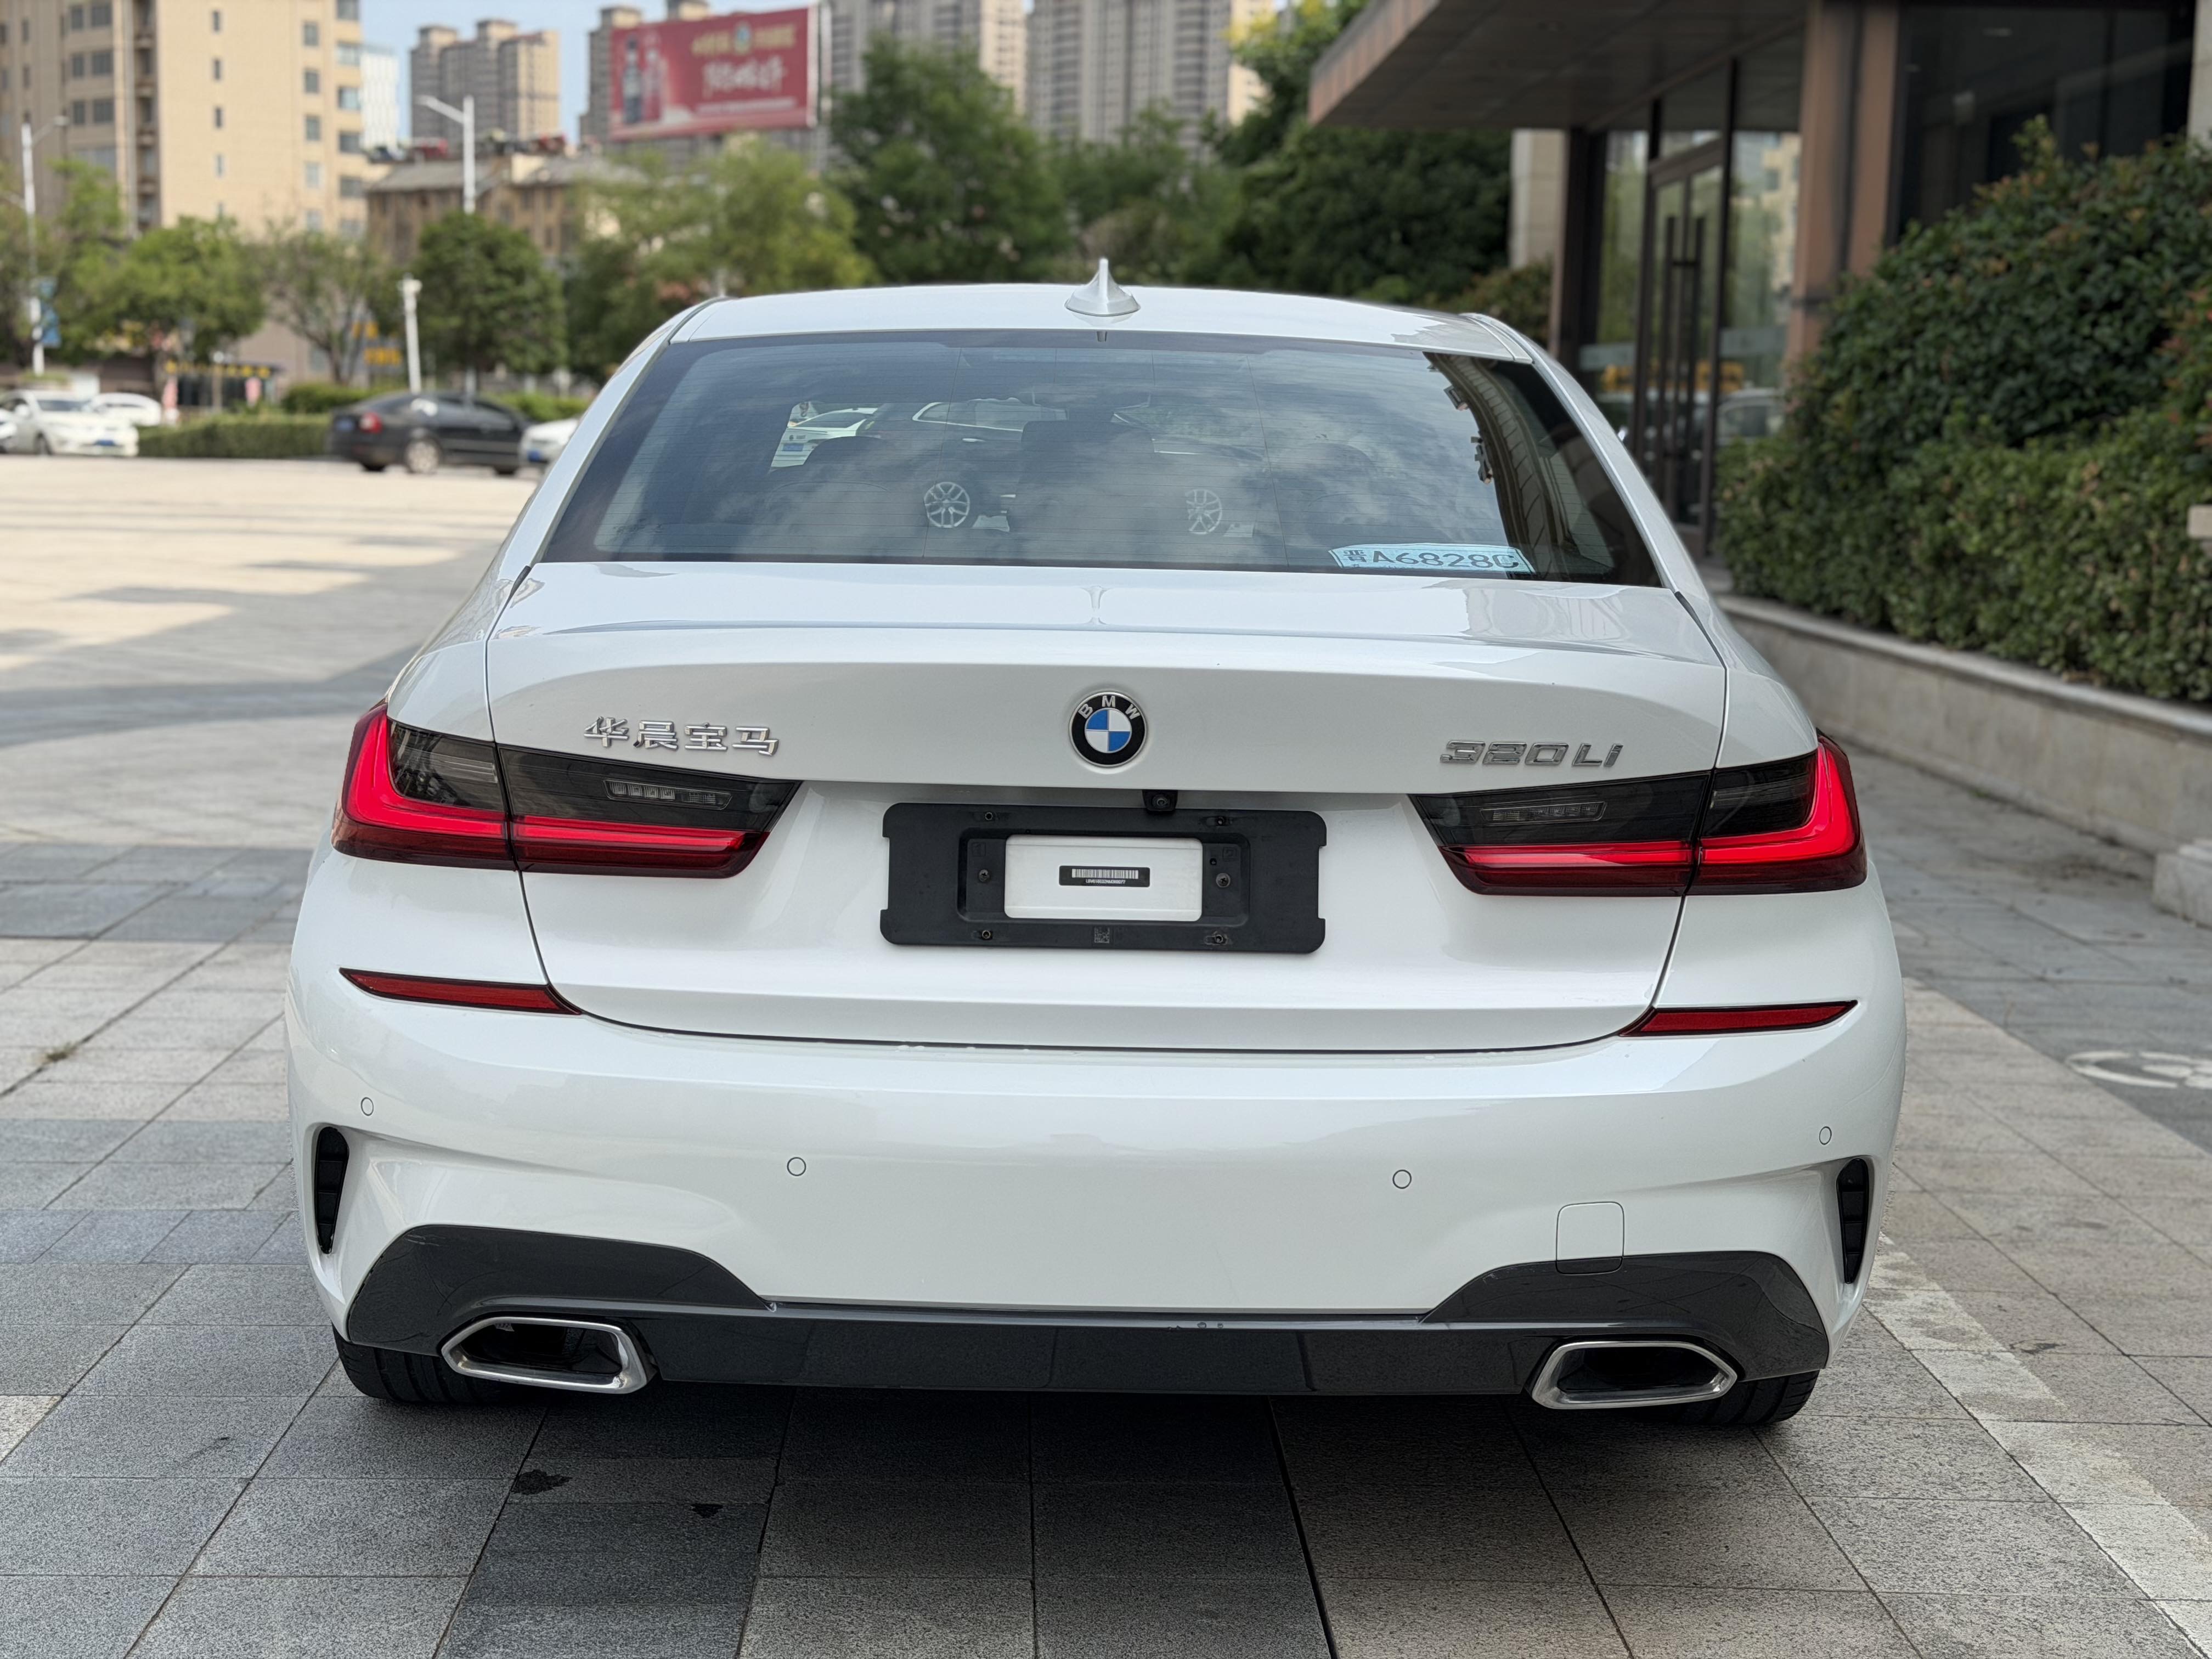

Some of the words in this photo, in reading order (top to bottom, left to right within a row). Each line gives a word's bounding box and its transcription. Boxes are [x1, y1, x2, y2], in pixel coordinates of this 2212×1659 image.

[1077, 695, 1141, 720] BMW
[583, 716, 780, 756] 华晨宝马
